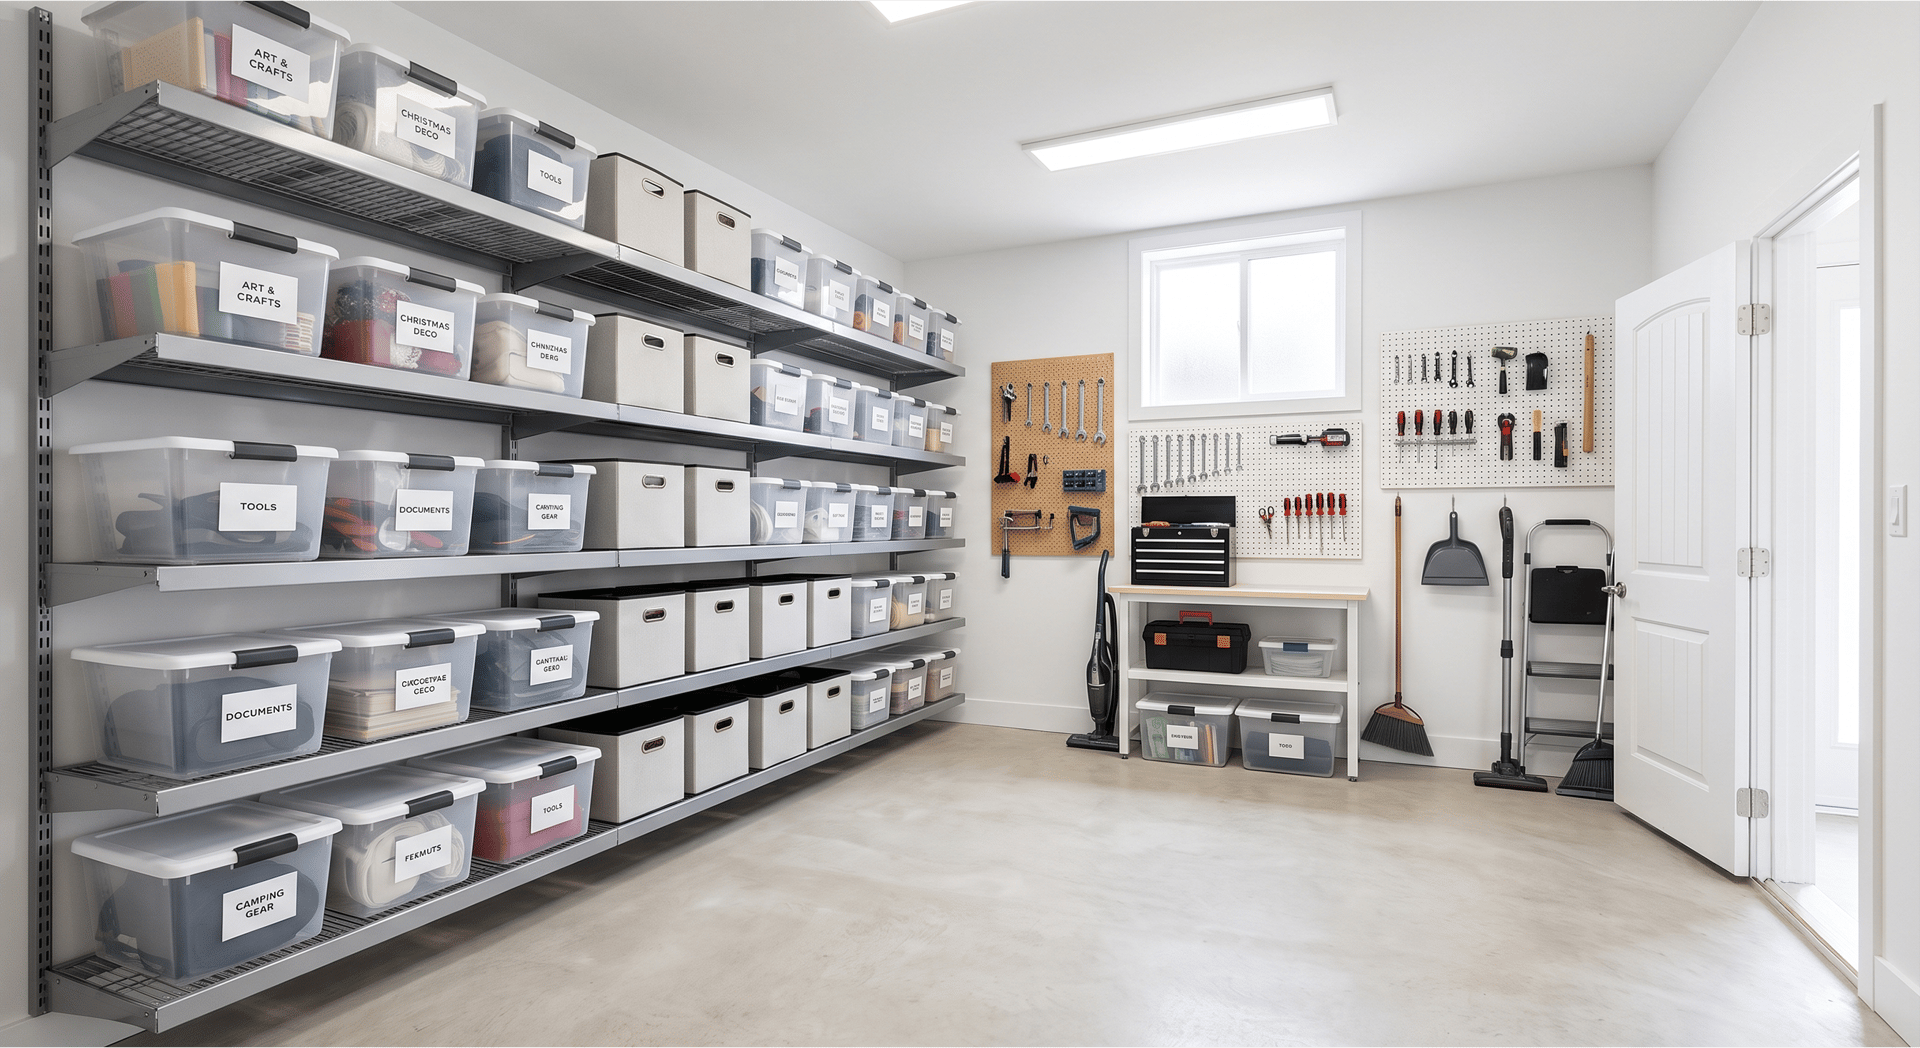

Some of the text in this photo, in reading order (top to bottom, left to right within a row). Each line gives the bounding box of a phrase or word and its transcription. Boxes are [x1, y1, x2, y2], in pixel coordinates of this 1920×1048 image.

[254, 48, 288, 69] ART &
[249, 59, 293, 82] CRAFTS
[401, 109, 451, 135] CHRISTMAS
[414, 125, 439, 140] DECO
[539, 170, 562, 185] TOOLS
[242, 281, 275, 295] ART &
[237, 292, 281, 308] CRAFTS
[400, 314, 450, 330] CHRISTMAS
[413, 327, 437, 338] DECO
[240, 502, 277, 511] TOOLS
[399, 506, 450, 515] DOCUMENTS
[226, 703, 293, 722] DOCUMENTS
[235, 888, 284, 911] CAMPING
[245, 902, 274, 918] GEAR
